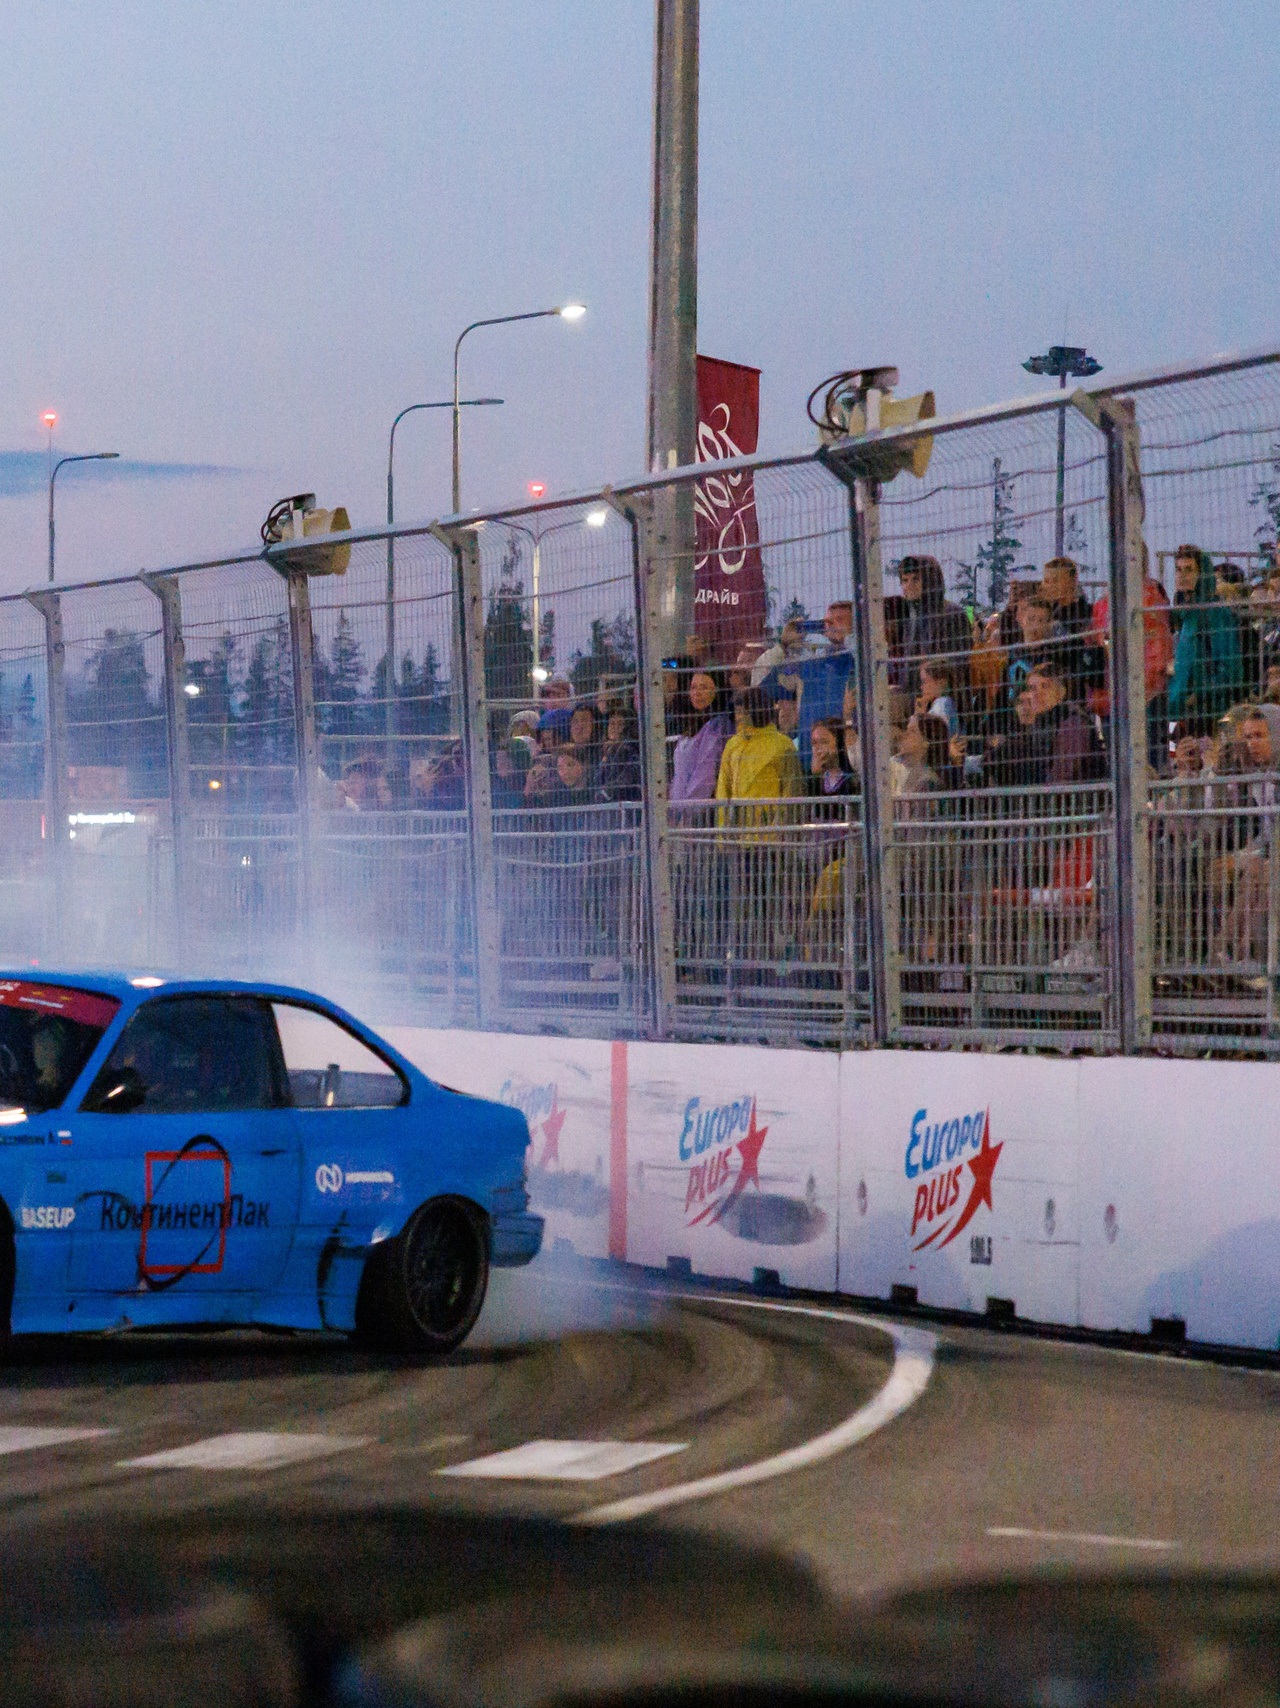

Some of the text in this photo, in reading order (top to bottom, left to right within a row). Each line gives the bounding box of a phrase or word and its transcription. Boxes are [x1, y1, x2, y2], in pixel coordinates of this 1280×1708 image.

[695, 588, 740, 606] ДРАЙВ
[679, 1095, 751, 1161] Europa
[904, 1108, 985, 1179] Europa
